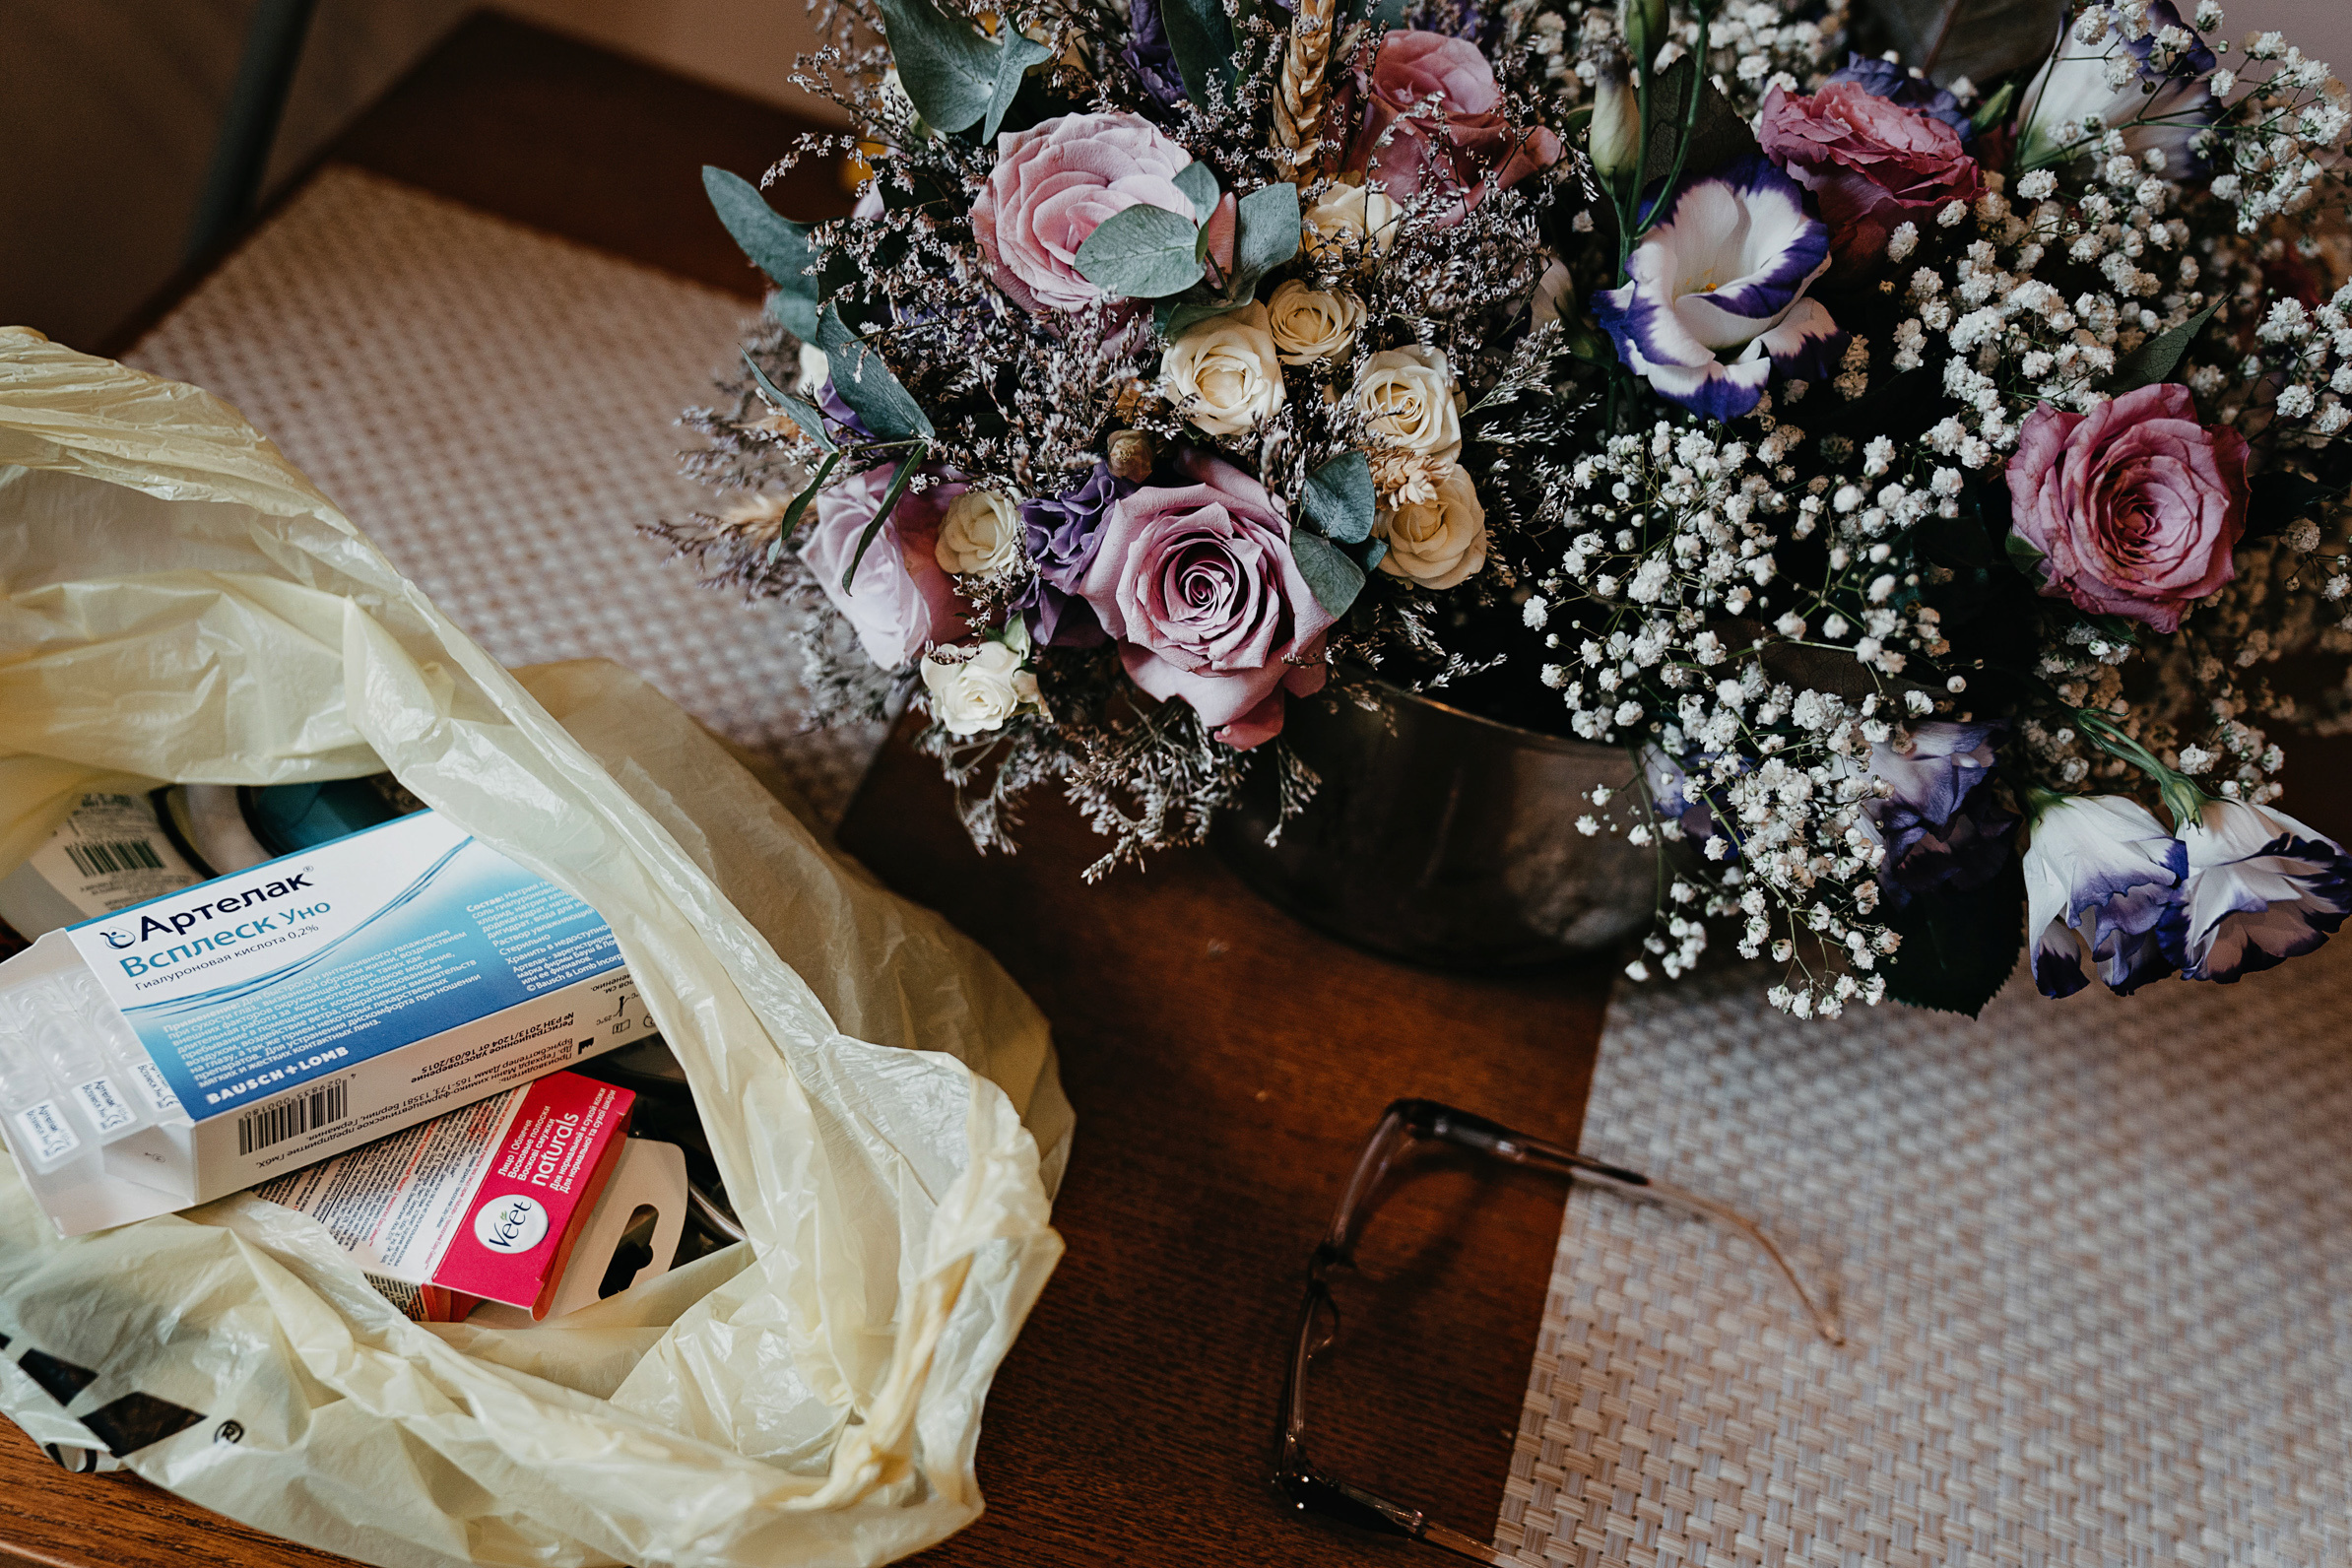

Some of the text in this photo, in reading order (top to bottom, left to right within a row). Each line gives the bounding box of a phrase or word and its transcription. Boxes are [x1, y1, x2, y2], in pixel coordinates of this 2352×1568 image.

[491, 906, 595, 947] Раствор увлажняющий
[548, 893, 576, 909] натри
[119, 901, 331, 978] Всплеск Уно
[134, 924, 319, 991] Гиалуроновая кислота 0,2%
[497, 933, 552, 955] Стерильно
[504, 947, 547, 965] Хранить
[553, 922, 613, 947] недоступно
[512, 956, 549, 973] Артелак
[516, 965, 544, 979] марка
[543, 954, 574, 970] фирмы
[571, 946, 596, 958] Бауш
[520, 955, 594, 985] или ее филиалов.
[162, 929, 452, 1033] Применение: Для быстрого и интенсивного увлажнения
[166, 931, 468, 1040] при сухости глаз, вызванной образом жизни, воздействием
[171, 953, 424, 1047] внешних факторов окружающей среды, таких как
[176, 951, 456, 1055] длительная работа за компьютером, редкое моргание,
[535, 973, 566, 989] Bausch
[571, 962, 597, 976] Lomb
[178, 1029, 248, 1060] пребывание
[256, 1007, 320, 1033] помещении
[329, 963, 442, 1008] кондиционированным
[184, 958, 477, 1068] воздухом, воздействие ветра, оперативных вмешательств
[188, 977, 449, 1075] на глазу, а так же прием некоторых лекарственных
[193, 1053, 262, 1081] препаратов.
[263, 1043, 287, 1057] Для
[285, 1021, 347, 1049] устранения
[347, 997, 416, 1027] дискомфорта
[415, 990, 436, 1002] при
[434, 973, 482, 995] ношении
[490, 1022, 543, 1048] 2013/1204
[197, 1018, 382, 1088] мягких и жестких контактных линз.
[410, 1018, 574, 1083] Регистрационное удостоверение
[421, 1048, 476, 1075] 16/03/2015
[479, 1042, 490, 1052] от
[496, 1153, 515, 1177] Лицо
[510, 1119, 533, 1150] Обличчя
[506, 1104, 551, 1179] Восковые полоски
[516, 1117, 557, 1181] Воскові смужки
[530, 1112, 579, 1187] naturals
[549, 1174, 563, 1192] Для
[557, 1131, 586, 1175] нормальной
[582, 1105, 598, 1127] сухой
[592, 1087, 607, 1106] кожи
[558, 1088, 617, 1195] Для нормальної та сухої шкіри
[489, 1201, 532, 1247] Veet
